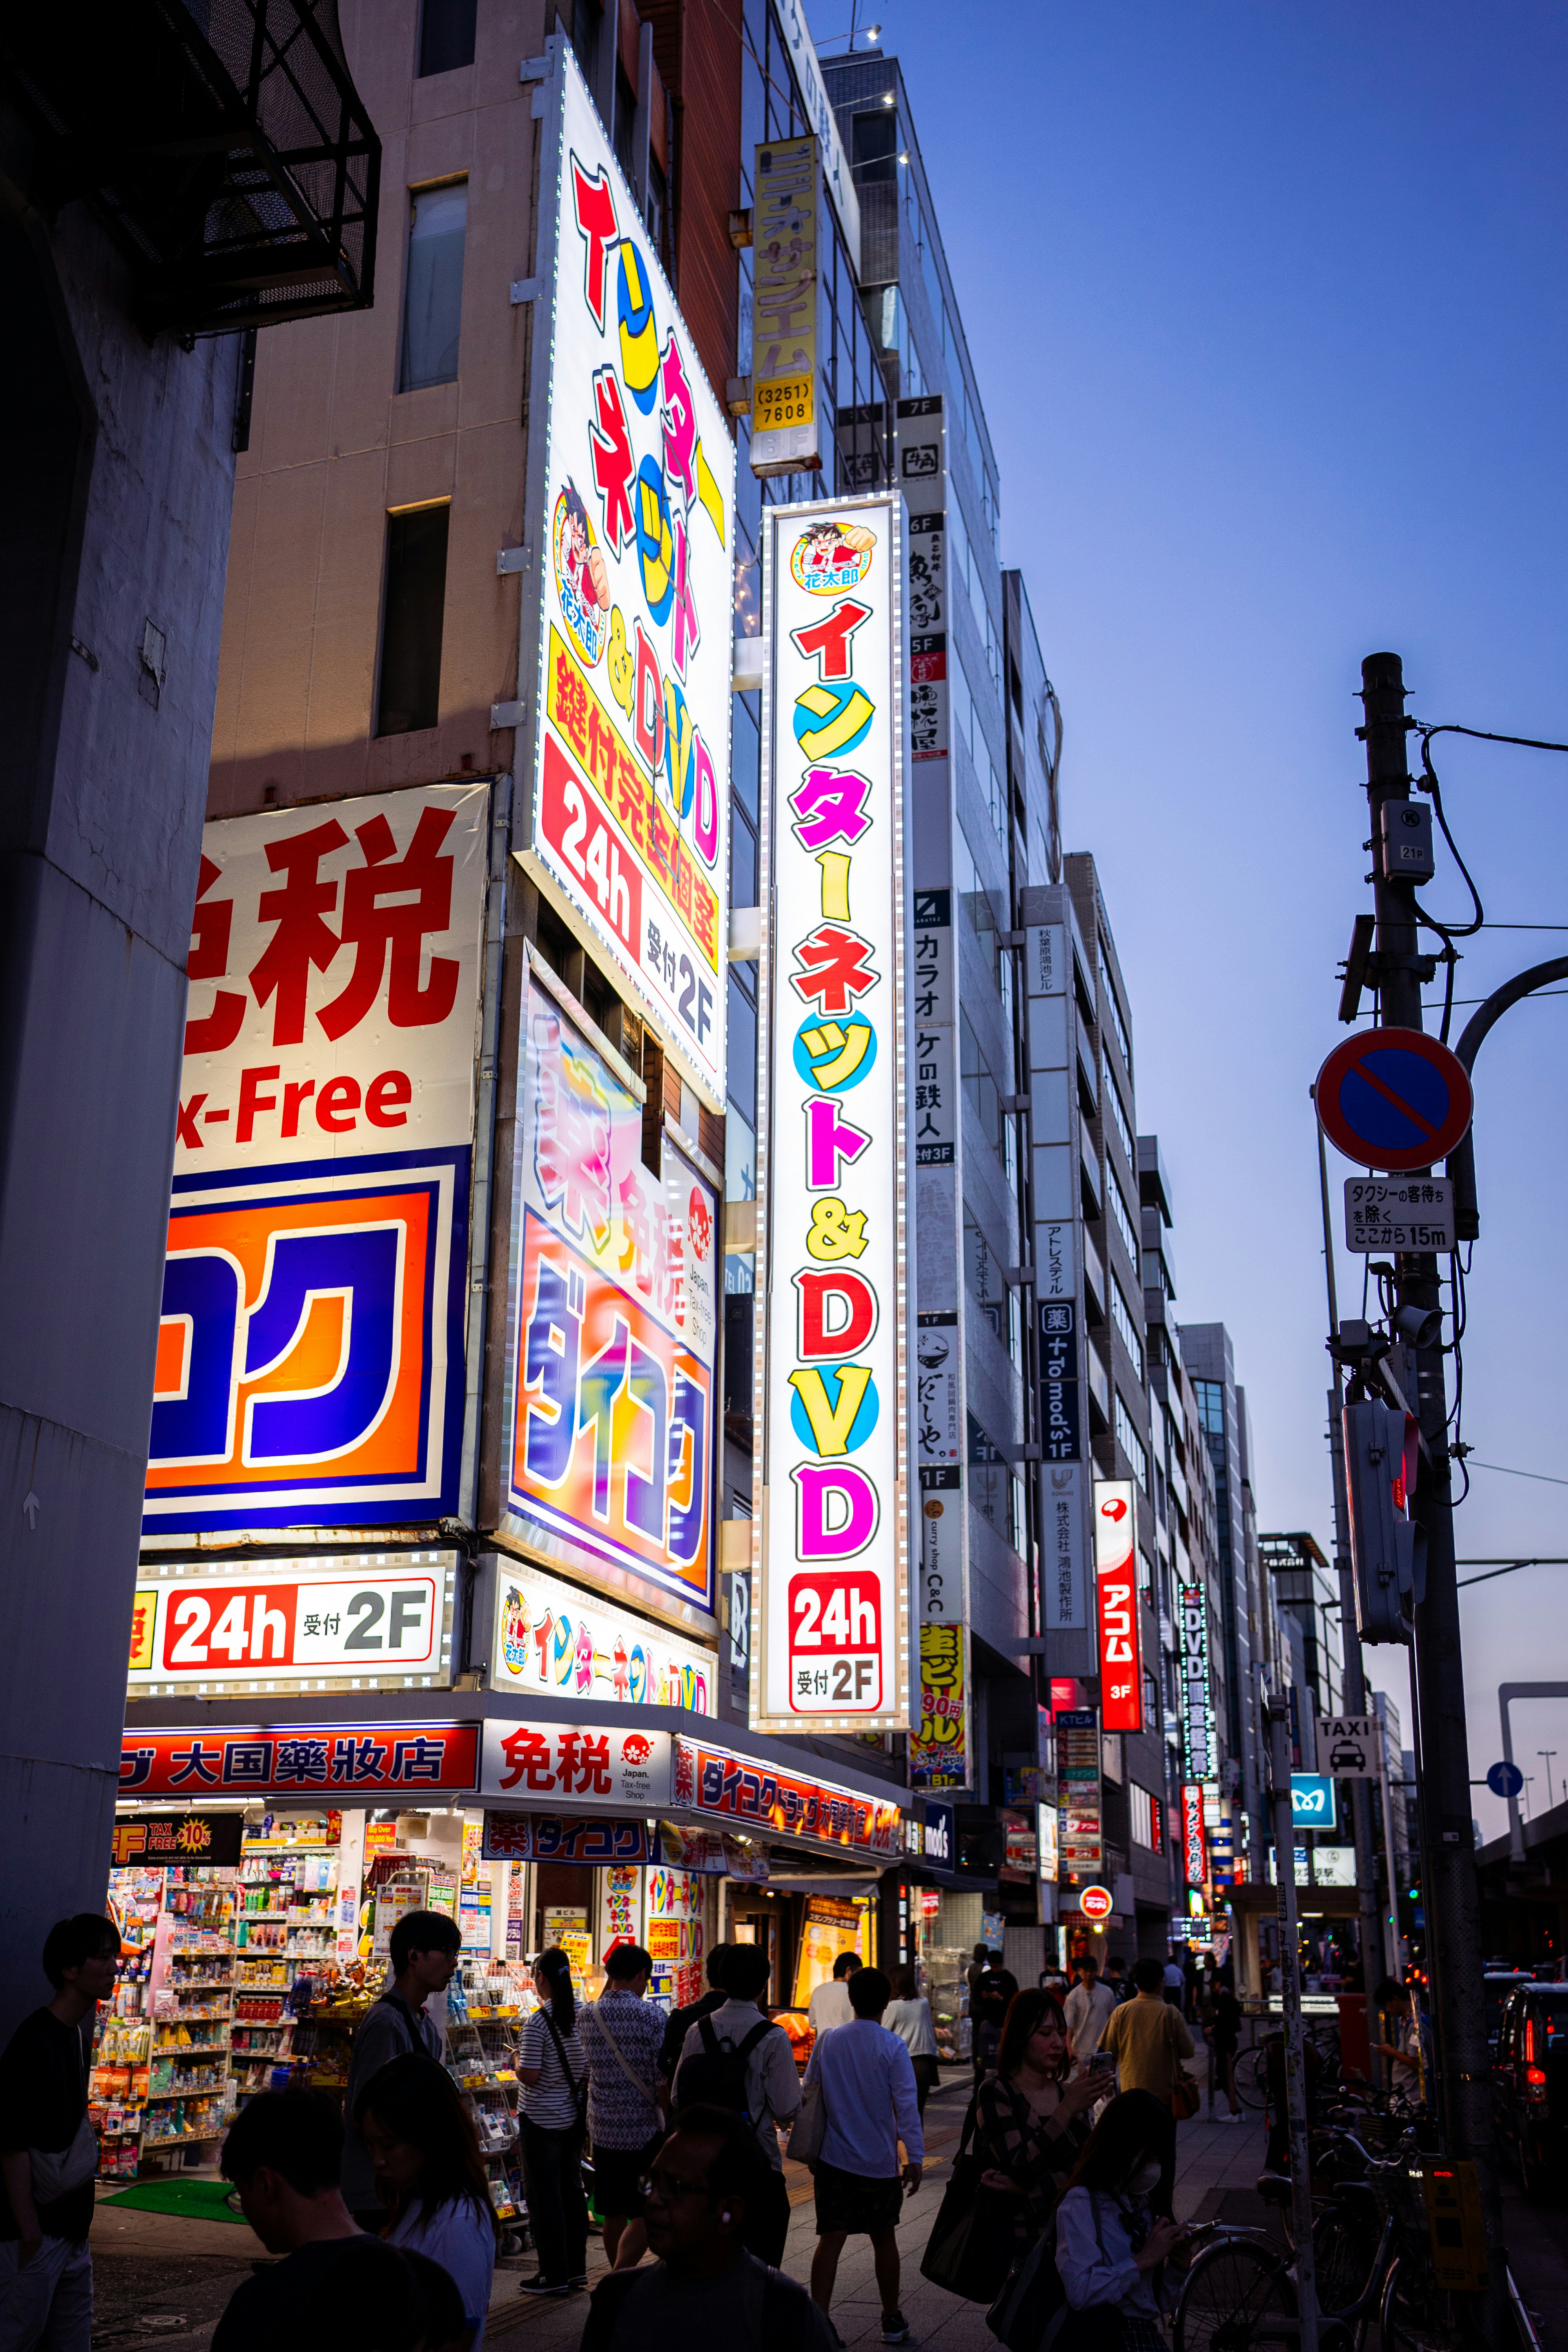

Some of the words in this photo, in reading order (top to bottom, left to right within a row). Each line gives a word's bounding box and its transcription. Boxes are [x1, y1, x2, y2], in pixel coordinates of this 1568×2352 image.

[758, 382, 809, 406] (3251)
[762, 405, 805, 423] 7608
[910, 401, 931, 414] 7F
[907, 452, 934, 469] 牛角
[910, 518, 932, 532] 6F
[861, 552, 869, 570] DVD
[804, 570, 858, 590] 花太郎
[912, 637, 933, 653] 5F
[555, 648, 716, 961] 鍵付完全個室
[1402, 846, 1423, 859] 21P
[562, 789, 631, 942] 24h
[647, 918, 677, 997] 受付
[678, 950, 713, 1044] 2F
[915, 935, 942, 1138] カラオケの鉄人
[1351, 1184, 1444, 1204] タクシーの客待ち
[1353, 1206, 1392, 1223] を除く
[618, 1167, 686, 1328] 免税
[1354, 1227, 1406, 1245] ここから
[1409, 1227, 1446, 1247] 15m
[1047, 1225, 1063, 1295] アトレスティル
[690, 1263, 710, 1298] Japan.
[688, 1288, 712, 1326] Tax-free
[1047, 1307, 1068, 1330] 薬
[692, 1317, 707, 1348] Shop
[524, 1251, 708, 1569] ダイコク
[1047, 1357, 1072, 1441] Tomod's
[1049, 1443, 1072, 1458] 1F
[921, 1470, 947, 1488] 1F
[929, 1521, 938, 1546] curry
[1056, 1501, 1070, 1552] 株式会社
[929, 1548, 940, 1570] shop
[927, 1573, 944, 1613] C&C
[1058, 1555, 1072, 1622] 鴻池製作所
[170, 1594, 287, 1663] 24h
[303, 1612, 341, 1637] 受付
[344, 1590, 426, 1650] 2F
[793, 1587, 877, 1647] 24h
[1103, 1584, 1134, 1662] アコム
[504, 1643, 525, 1667] 花太郎
[1185, 1608, 1204, 1680] DVD
[796, 1670, 829, 1697] 受付
[831, 1660, 873, 1701] 2F
[1110, 1685, 1131, 1699] 3F
[1059, 1715, 1093, 1725] KTビル
[1319, 1721, 1370, 1737] TAXI
[498, 1726, 613, 1796] 免税
[674, 1740, 694, 1804] 薬
[621, 1780, 651, 1790] Tax-free
[622, 1768, 650, 1779] Japan.
[931, 1773, 956, 1786] B1F
[625, 1791, 645, 1800] Shop
[149, 1823, 173, 1836] TAX
[178, 1823, 211, 1846] +10%
[368, 1825, 377, 1834] Buy
[378, 1825, 391, 1833] Over
[488, 1812, 530, 1855] 薬
[536, 1818, 643, 1857] ダイコク
[1079, 1822, 1099, 1831] アコム
[148, 1837, 178, 1850] FREE
[386, 1835, 395, 1843] Yen
[606, 1894, 637, 1908] インター
[610, 1908, 631, 1922] ネット
[606, 1923, 633, 1933] &DVD
[680, 1917, 703, 1960] DVD
